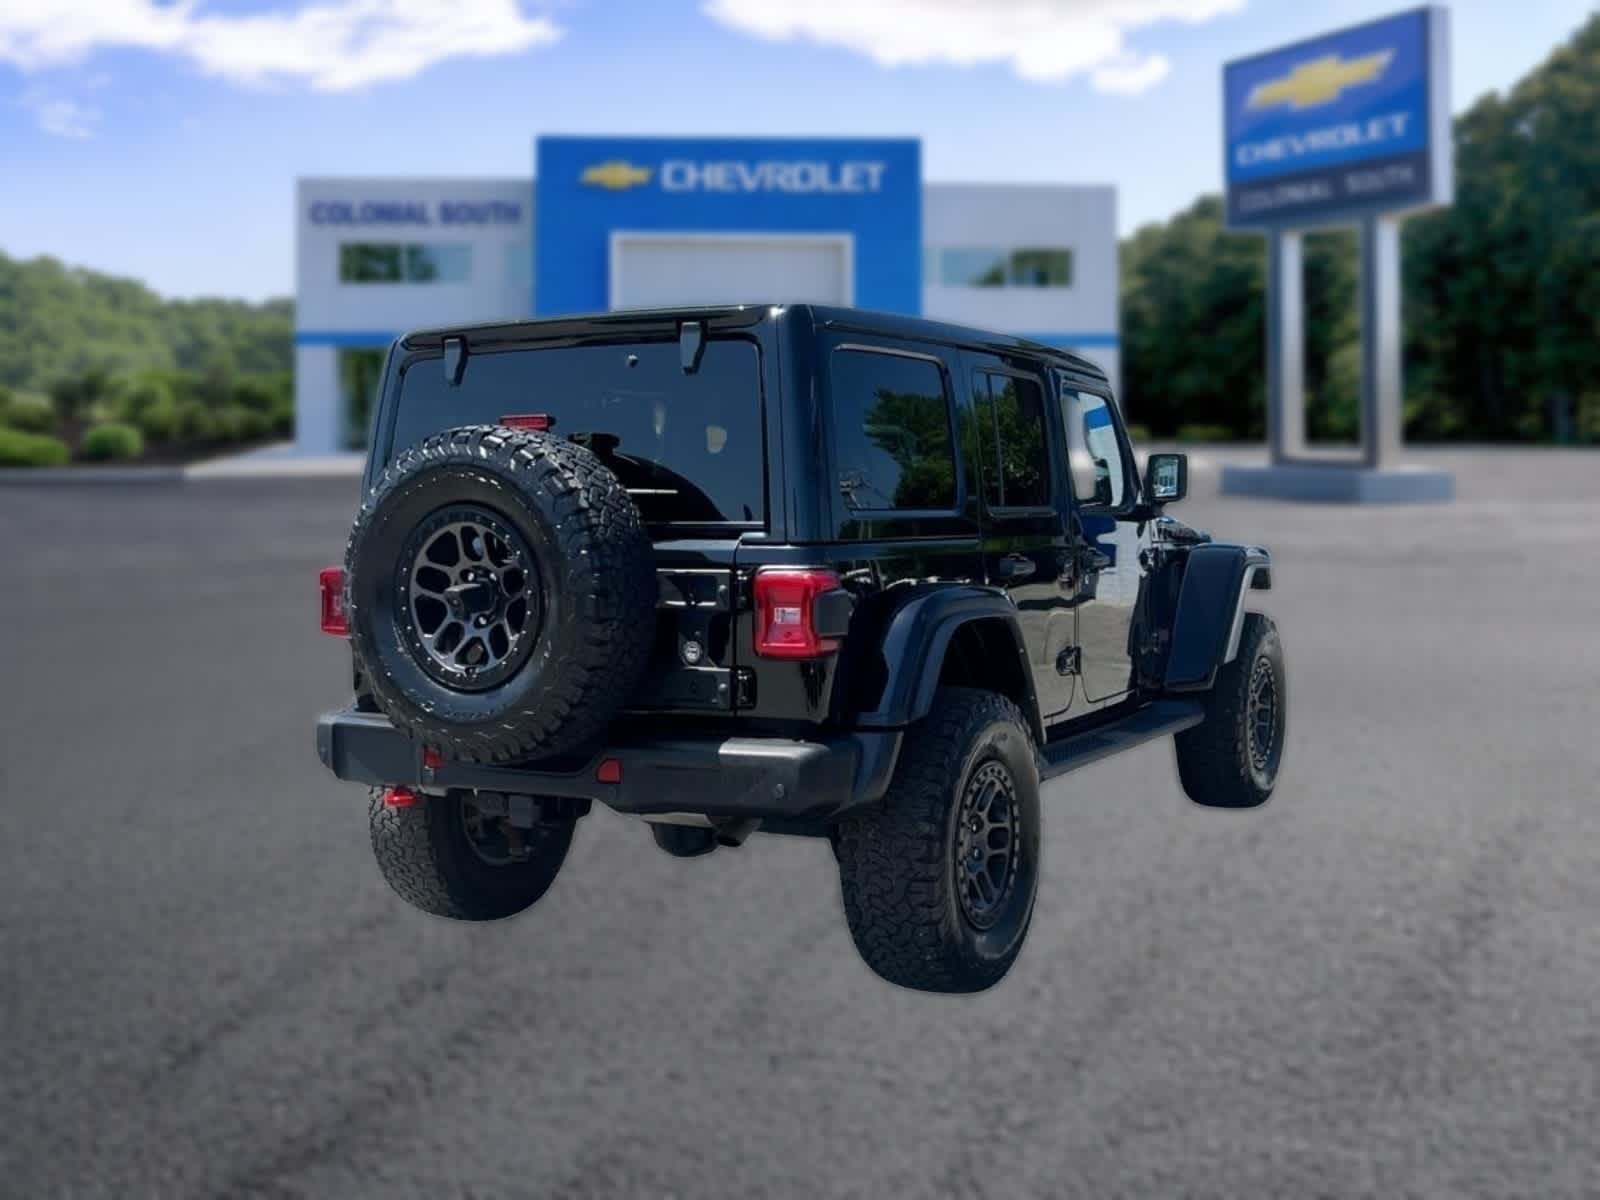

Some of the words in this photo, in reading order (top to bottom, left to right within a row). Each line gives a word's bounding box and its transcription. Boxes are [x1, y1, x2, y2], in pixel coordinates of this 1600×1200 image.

[1236, 112, 1408, 166] CHEVROLET
[662, 161, 884, 192] CHEVROLET
[310, 200, 431, 225] COLONIAL
[440, 200, 521, 225] SOUTH
